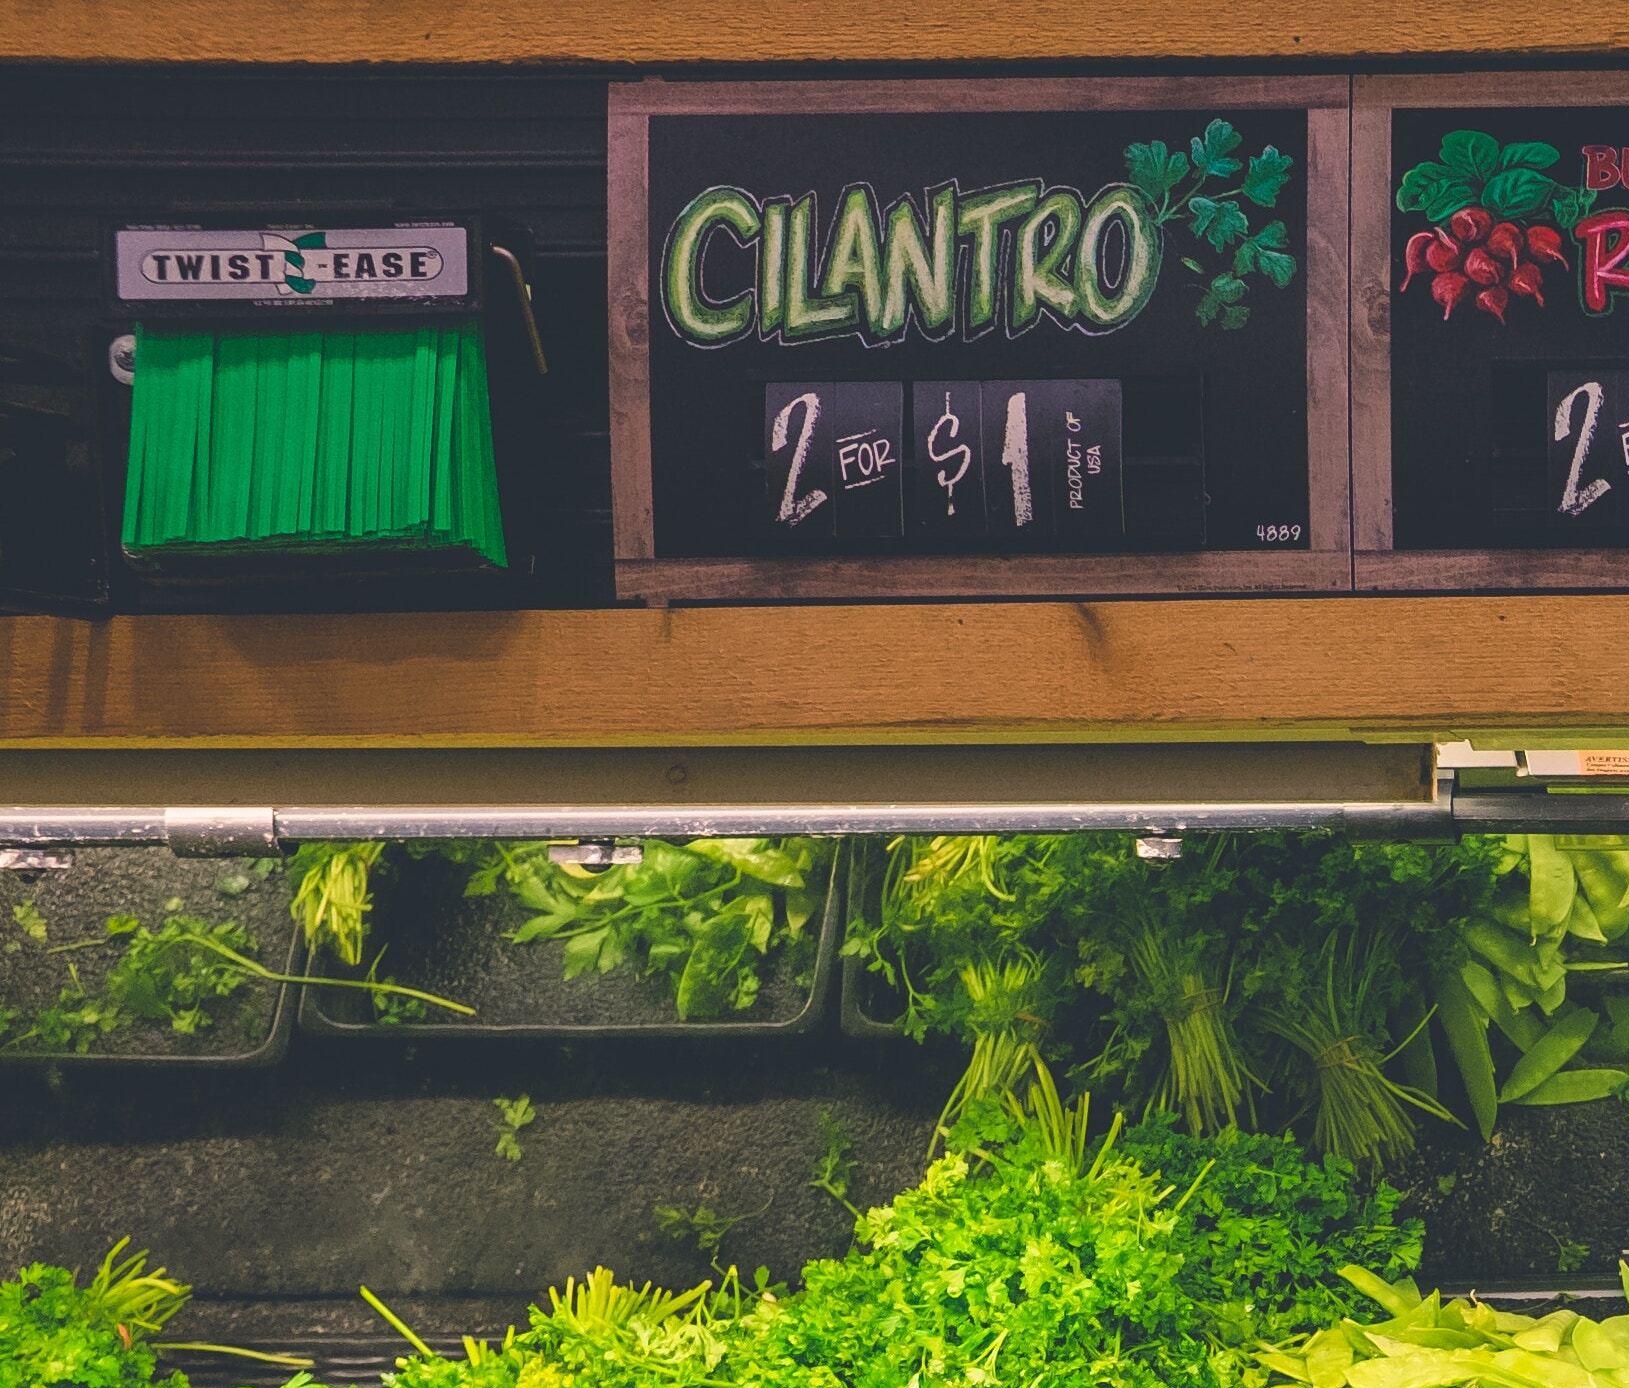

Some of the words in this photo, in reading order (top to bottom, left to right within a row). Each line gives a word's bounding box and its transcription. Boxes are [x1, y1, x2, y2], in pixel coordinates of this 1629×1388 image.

[152, 254, 275, 281] TWIST
[660, 178, 1163, 348] CILANTRO
[1066, 411, 1082, 432] OF
[772, 393, 827, 527] 2
[838, 437, 896, 482] FOR
[1067, 435, 1083, 509] PRODUCT
[1088, 446, 1101, 475] USA
[1555, 381, 1612, 517] 2
[1255, 524, 1302, 542] 4889
